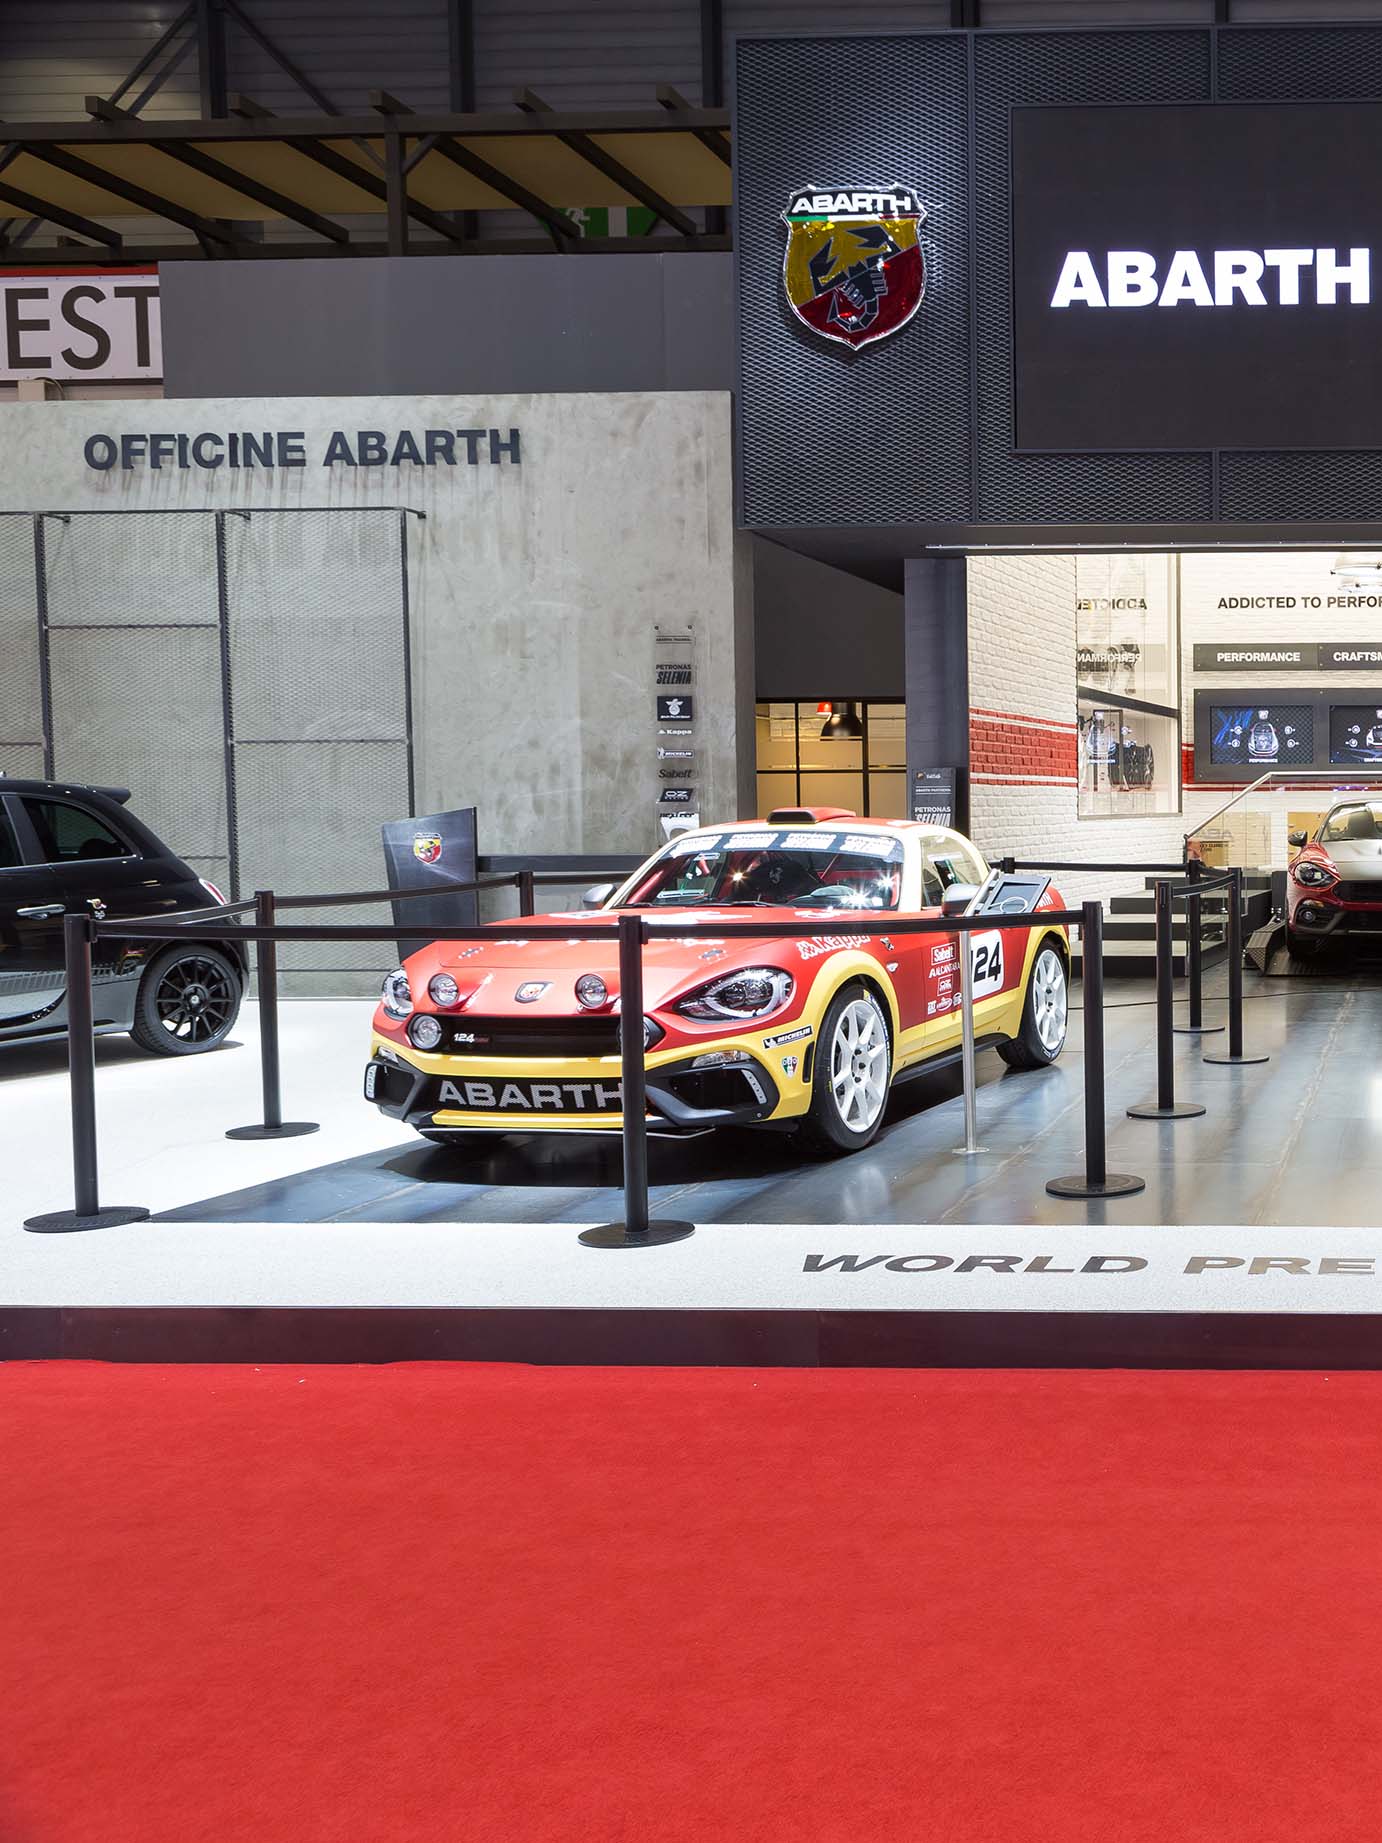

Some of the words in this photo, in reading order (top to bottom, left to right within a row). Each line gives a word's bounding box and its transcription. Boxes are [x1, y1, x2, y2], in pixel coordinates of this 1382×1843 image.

[792, 192, 912, 213] ABARTH
[1050, 247, 1371, 309] ABARTH
[3, 285, 160, 370] EST
[84, 430, 307, 471] OFFICINE
[323, 428, 522, 467] ABARTH
[1217, 597, 1297, 609] ADDICTED
[1301, 597, 1322, 608] TO
[1216, 652, 1301, 662] PERFORMANCE
[656, 671, 692, 685] SELENIA
[658, 768, 693, 778] Sabelt
[454, 1033, 474, 1043] 124
[777, 1027, 811, 1043] MICHELIN
[439, 1080, 624, 1109] ABARTH
[801, 1254, 1149, 1275] WORLD
